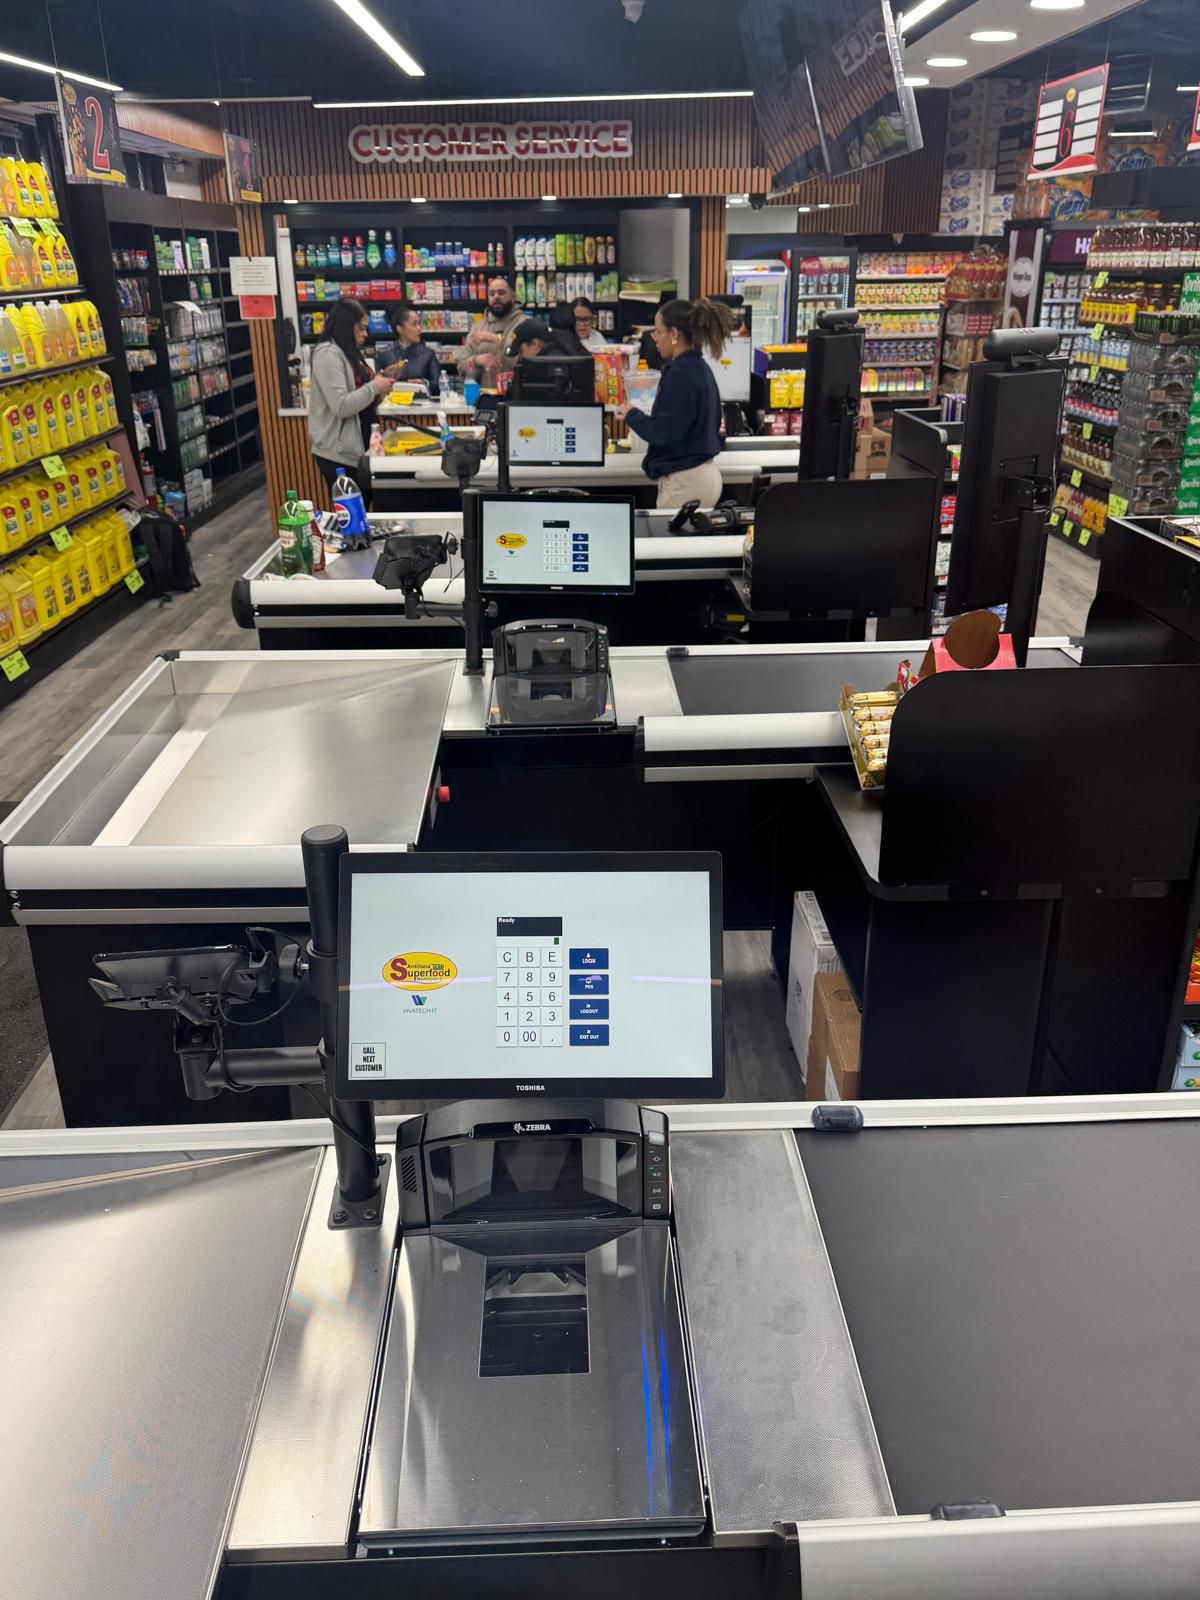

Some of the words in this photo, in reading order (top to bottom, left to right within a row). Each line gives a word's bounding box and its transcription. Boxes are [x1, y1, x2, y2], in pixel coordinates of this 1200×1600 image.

[85, 96, 111, 174] 2
[1058, 111, 1075, 158] 6
[352, 126, 509, 158] CUSTOMER
[514, 123, 630, 155] SERVICE
[503, 951, 512, 963] C
[526, 951, 534, 963] B
[548, 951, 556, 963] E
[390, 957, 451, 982] Superfood
[503, 972, 511, 982] 7
[526, 972, 534, 982] 8
[548, 972, 556, 982] 9
[503, 992, 511, 1002] 4
[526, 992, 534, 1002] 5
[548, 992, 556, 1002] 6
[504, 1011, 510, 1021] 1
[526, 1011, 533, 1021] 2
[548, 1011, 556, 1022] 3
[503, 1031, 511, 1042] 0
[522, 1031, 537, 1042] 00
[362, 1046, 376, 1054] CALL
[362, 1055, 376, 1063] NEXT
[354, 1064, 383, 1072] CUSTOMER
[525, 1124, 551, 1132] ZEBRA
